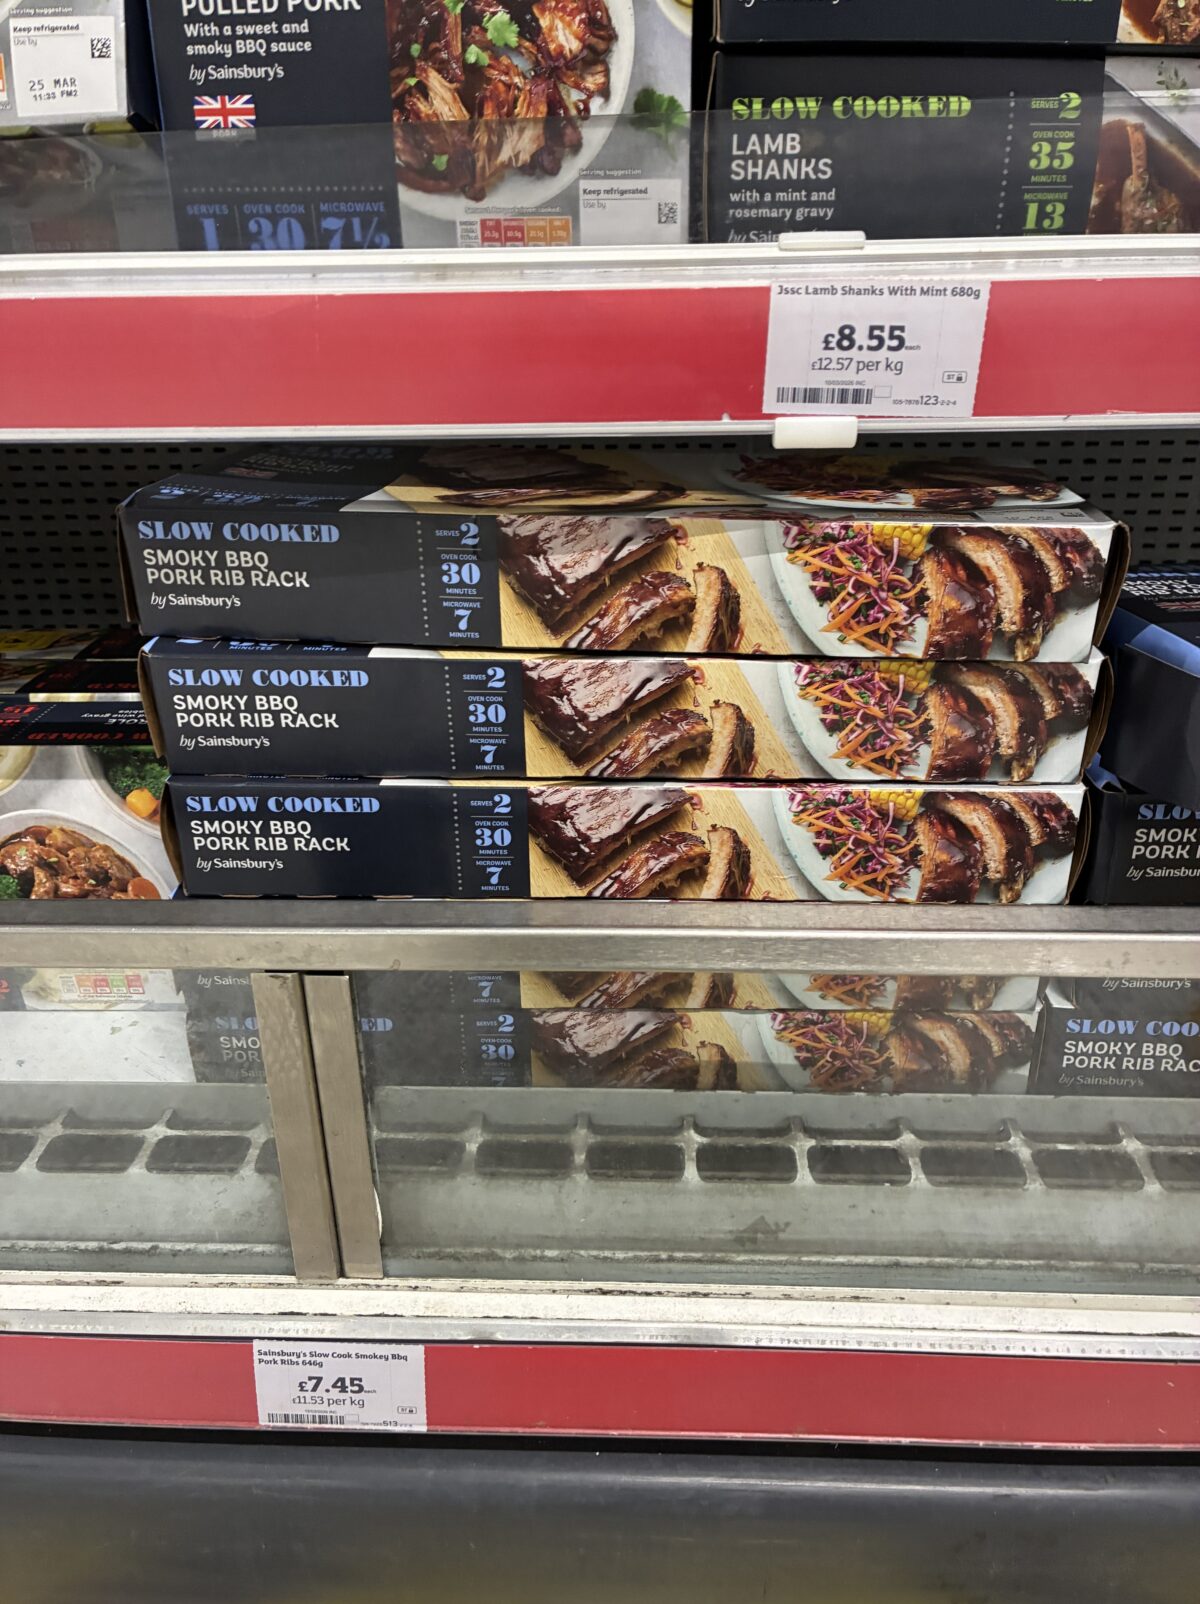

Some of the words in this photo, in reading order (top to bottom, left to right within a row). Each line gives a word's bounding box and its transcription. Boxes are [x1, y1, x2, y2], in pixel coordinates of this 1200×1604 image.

[182, 0, 278, 17] PULLED
[13, 25, 32, 34] Keep
[33, 24, 80, 33] refrigerated
[184, 23, 220, 37] With
[223, 25, 232, 35] a
[235, 21, 278, 36] sweet
[282, 19, 310, 34] and
[186, 41, 232, 58] smoky
[236, 39, 267, 56] BBQ
[270, 40, 312, 53] sauce
[189, 64, 207, 85] by
[208, 62, 284, 82] Sainsbury's
[29, 79, 45, 92] 25
[54, 77, 77, 89] MAR
[731, 96, 822, 121] SLOW
[833, 94, 972, 119] COOKED
[1031, 100, 1059, 109] SERVES
[1059, 92, 1082, 119] 2
[1032, 131, 1053, 139] OVEN
[1054, 131, 1075, 139] COOK
[732, 134, 801, 156] LAMB
[1029, 141, 1076, 170] 35
[730, 158, 833, 181] SHANKS
[1031, 175, 1067, 183] MINUTES
[583, 188, 601, 197] Keep
[603, 187, 649, 196] refrigerated
[729, 189, 759, 203] with
[762, 192, 772, 203] a
[775, 188, 807, 203] mint
[811, 187, 836, 202] and
[1024, 192, 1068, 200] MICROWAVE
[186, 204, 229, 215] SERVES
[243, 203, 272, 214] OVEN
[274, 203, 305, 214] COOK
[320, 201, 385, 212] MICROWAVE
[729, 207, 791, 221] rosemary
[796, 206, 834, 221] gravy
[1022, 202, 1065, 230] 13
[201, 217, 219, 249] 1
[248, 216, 306, 249] 30
[777, 284, 803, 296] Jssc
[805, 284, 838, 296] Lamb
[841, 285, 884, 296] Shanks
[888, 286, 917, 297] With
[920, 286, 948, 297] Mint
[951, 286, 981, 300] 680g
[822, 324, 906, 352] £8.55
[812, 358, 853, 371] £12.57
[856, 359, 881, 374] per
[886, 358, 904, 375] kg
[138, 520, 214, 540] SLOW
[222, 522, 340, 543] COOKED
[459, 522, 481, 546] 2
[143, 549, 219, 567] SMOKY
[225, 550, 270, 571] BBQ
[459, 553, 478, 561] COOK
[146, 567, 205, 586] PORK
[210, 569, 244, 587] RIB
[251, 570, 310, 588] RACK
[441, 563, 481, 585] 30
[150, 591, 167, 609] by
[168, 594, 241, 609] Sainsbury's
[442, 600, 481, 609] MICROWAVE
[453, 609, 472, 631] 7
[448, 631, 480, 639] MINUTES
[168, 667, 243, 687] SLOW
[251, 669, 369, 687] COOKED
[486, 666, 506, 689] 2
[173, 694, 246, 711] SMOKY
[255, 695, 299, 714] BBQ
[176, 712, 234, 728] PORK
[240, 712, 275, 728] RIB
[281, 713, 339, 729] RACK
[468, 703, 506, 724] 30
[179, 733, 196, 750] by
[197, 735, 270, 749] Sainsbury's
[469, 737, 507, 745] MICROWAVE
[481, 745, 499, 764] 7
[185, 796, 260, 813] SLOW
[267, 796, 380, 813] COOKED
[493, 793, 512, 813] 2
[190, 820, 261, 835] SMOKY
[269, 820, 312, 838] BBQ
[475, 828, 512, 847] 30
[1134, 828, 1200, 843] SMOK
[193, 836, 249, 851] PORK
[254, 837, 289, 851] RIB
[294, 837, 350, 852] RACK
[1131, 845, 1191, 860] PORK
[196, 857, 212, 872] by
[213, 857, 284, 871] Sainsbury's
[1126, 865, 1144, 881] by
[485, 866, 503, 885] 7
[197, 974, 212, 988] by
[478, 981, 494, 998] 7
[1102, 978, 1119, 991] by
[1121, 978, 1192, 991] Sainsbury's
[497, 1014, 515, 1032] 2
[1066, 1019, 1139, 1035] SLOW
[1146, 1020, 1200, 1037] COO
[481, 1044, 515, 1060] 30
[1064, 1041, 1137, 1055] SMOKY
[1141, 1043, 1183, 1060] BBQ
[1062, 1055, 1117, 1070] PORK
[1122, 1057, 1155, 1071] RIB
[1058, 1073, 1075, 1087] by
[1076, 1075, 1145, 1087] Sainsbury's
[257, 1348, 307, 1359] Sainsbury's
[309, 1351, 330, 1359] Slow
[355, 1352, 389, 1361] Smokey
[391, 1353, 408, 1362] Bbq
[280, 1358, 300, 1366] Ribs
[302, 1359, 323, 1368] 646g
[298, 1376, 365, 1394] £7.45
[292, 1395, 325, 1405] £11.53
[327, 1397, 347, 1408] per
[350, 1396, 365, 1408] kg
